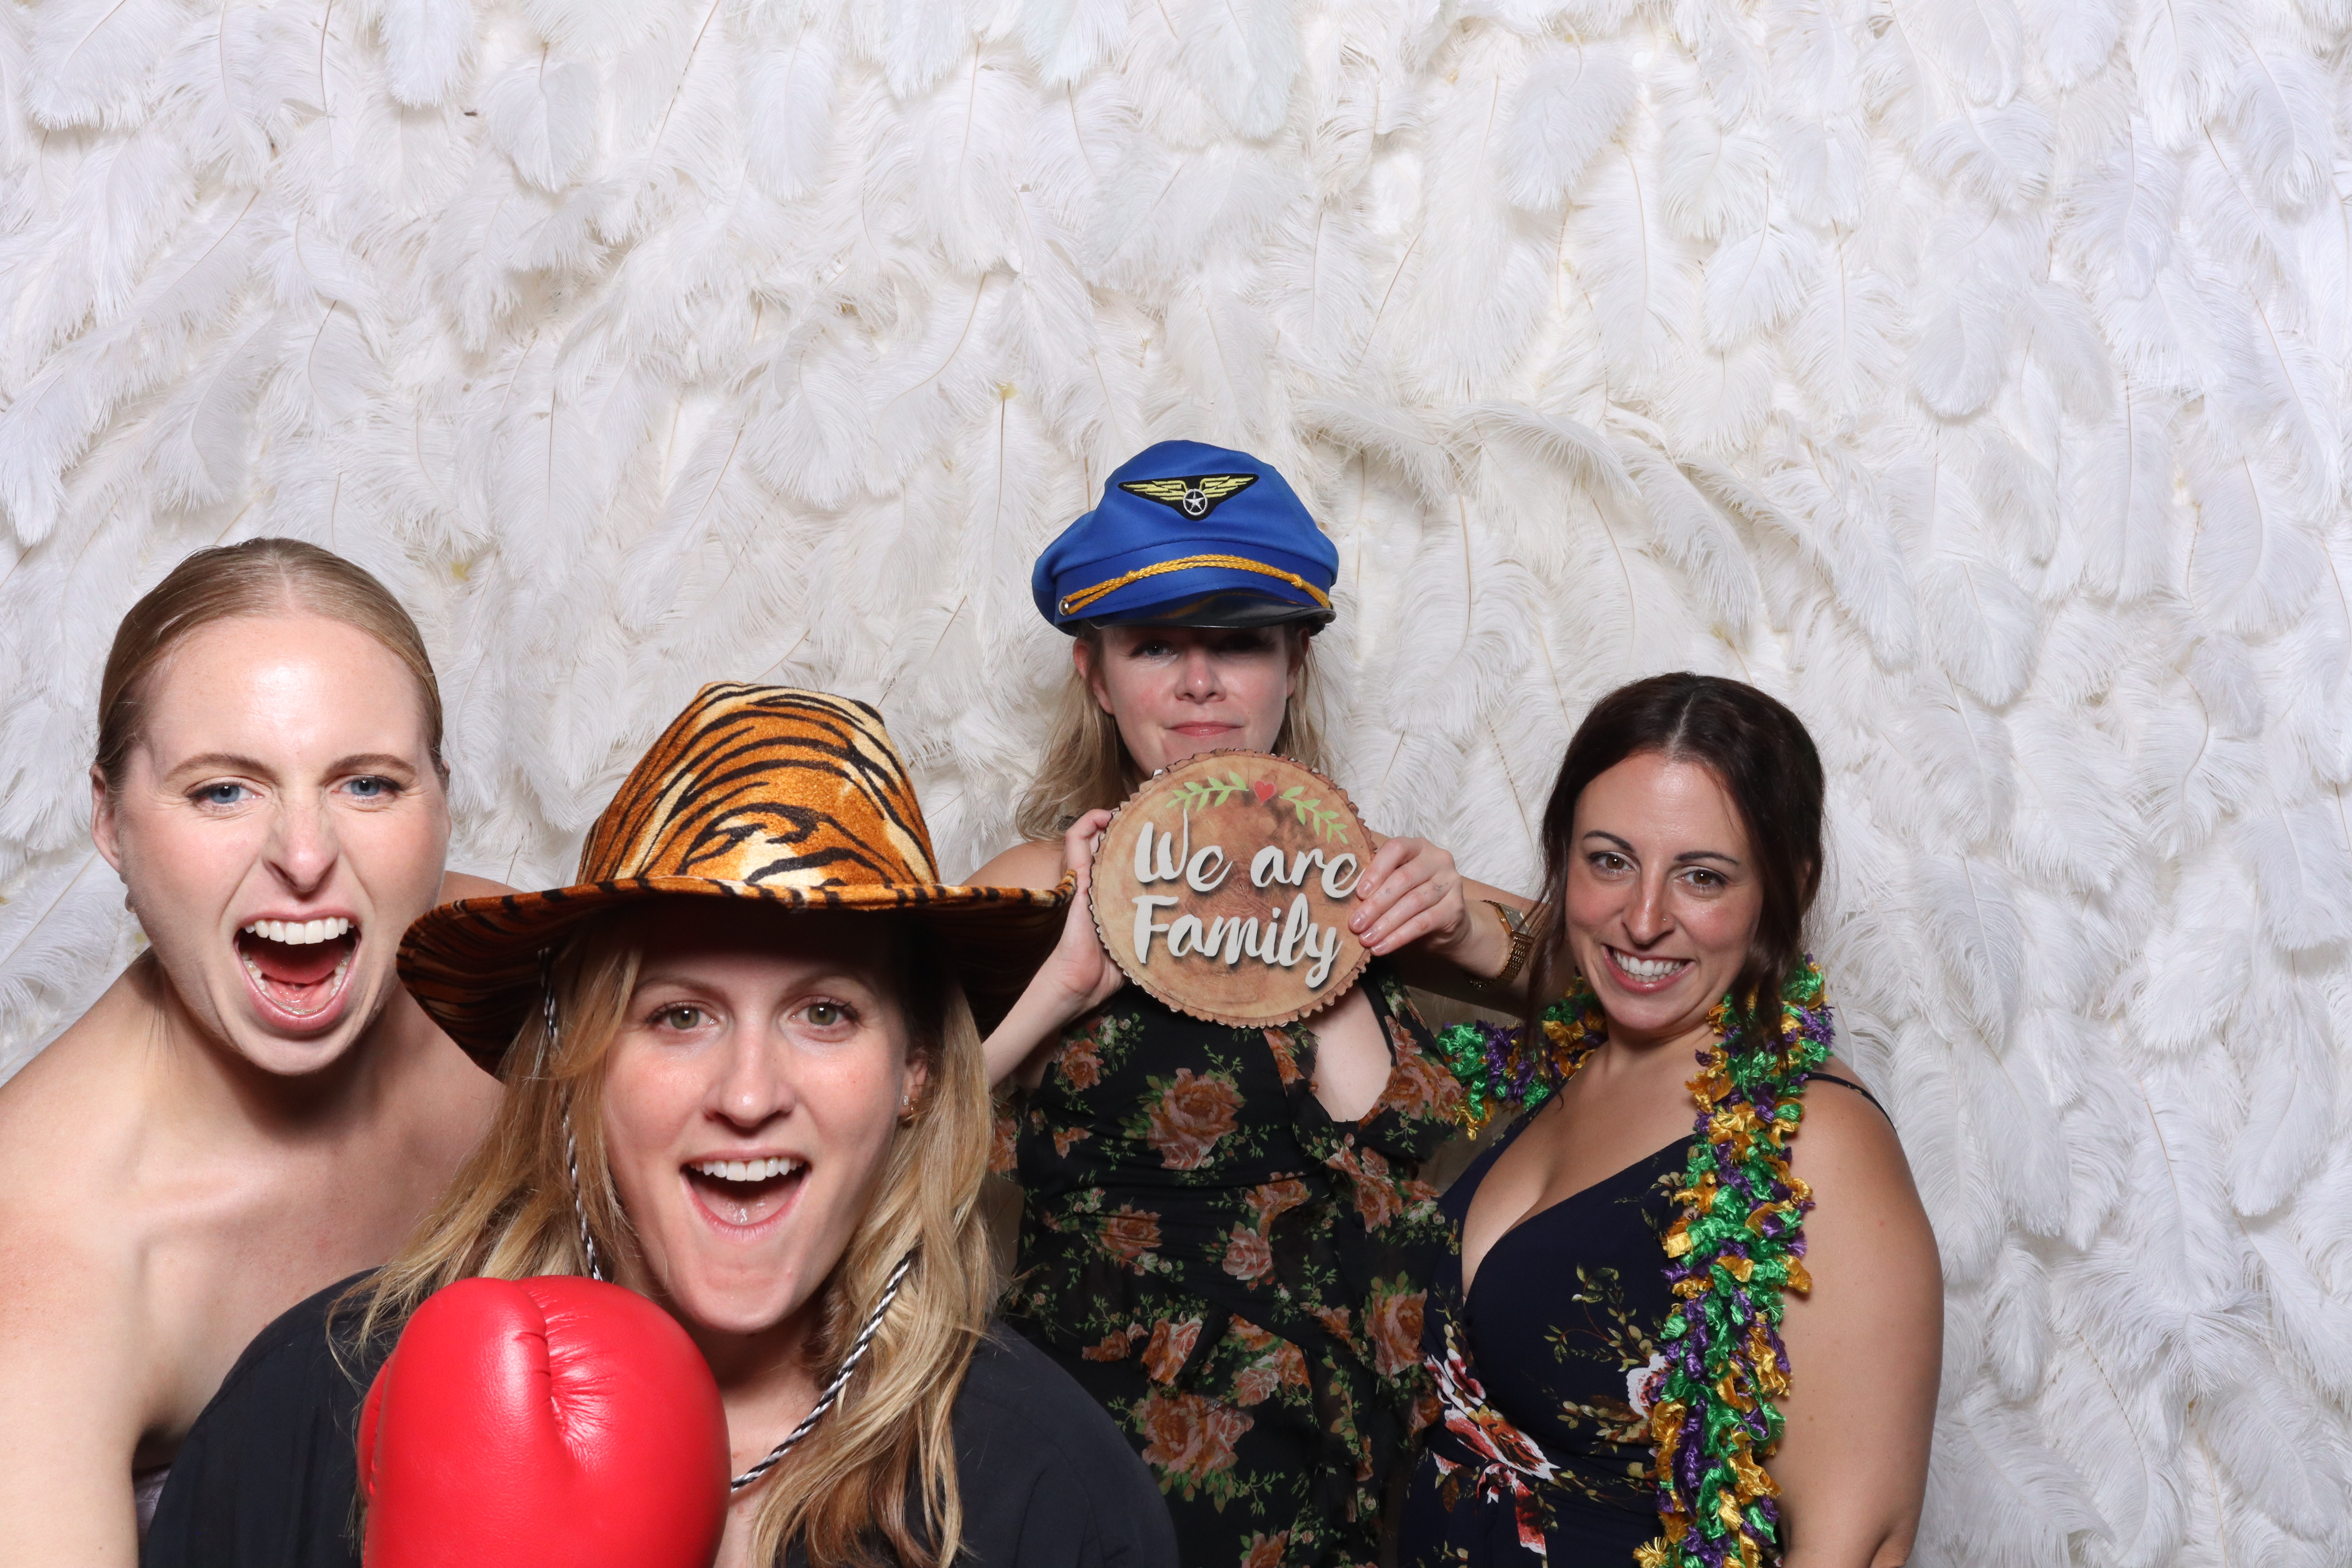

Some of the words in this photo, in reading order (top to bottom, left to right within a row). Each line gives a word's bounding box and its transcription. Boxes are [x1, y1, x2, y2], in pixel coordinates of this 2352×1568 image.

[1134, 809, 1233, 892] We
[1250, 846, 1366, 898] are
[1132, 893, 1343, 988] Family
